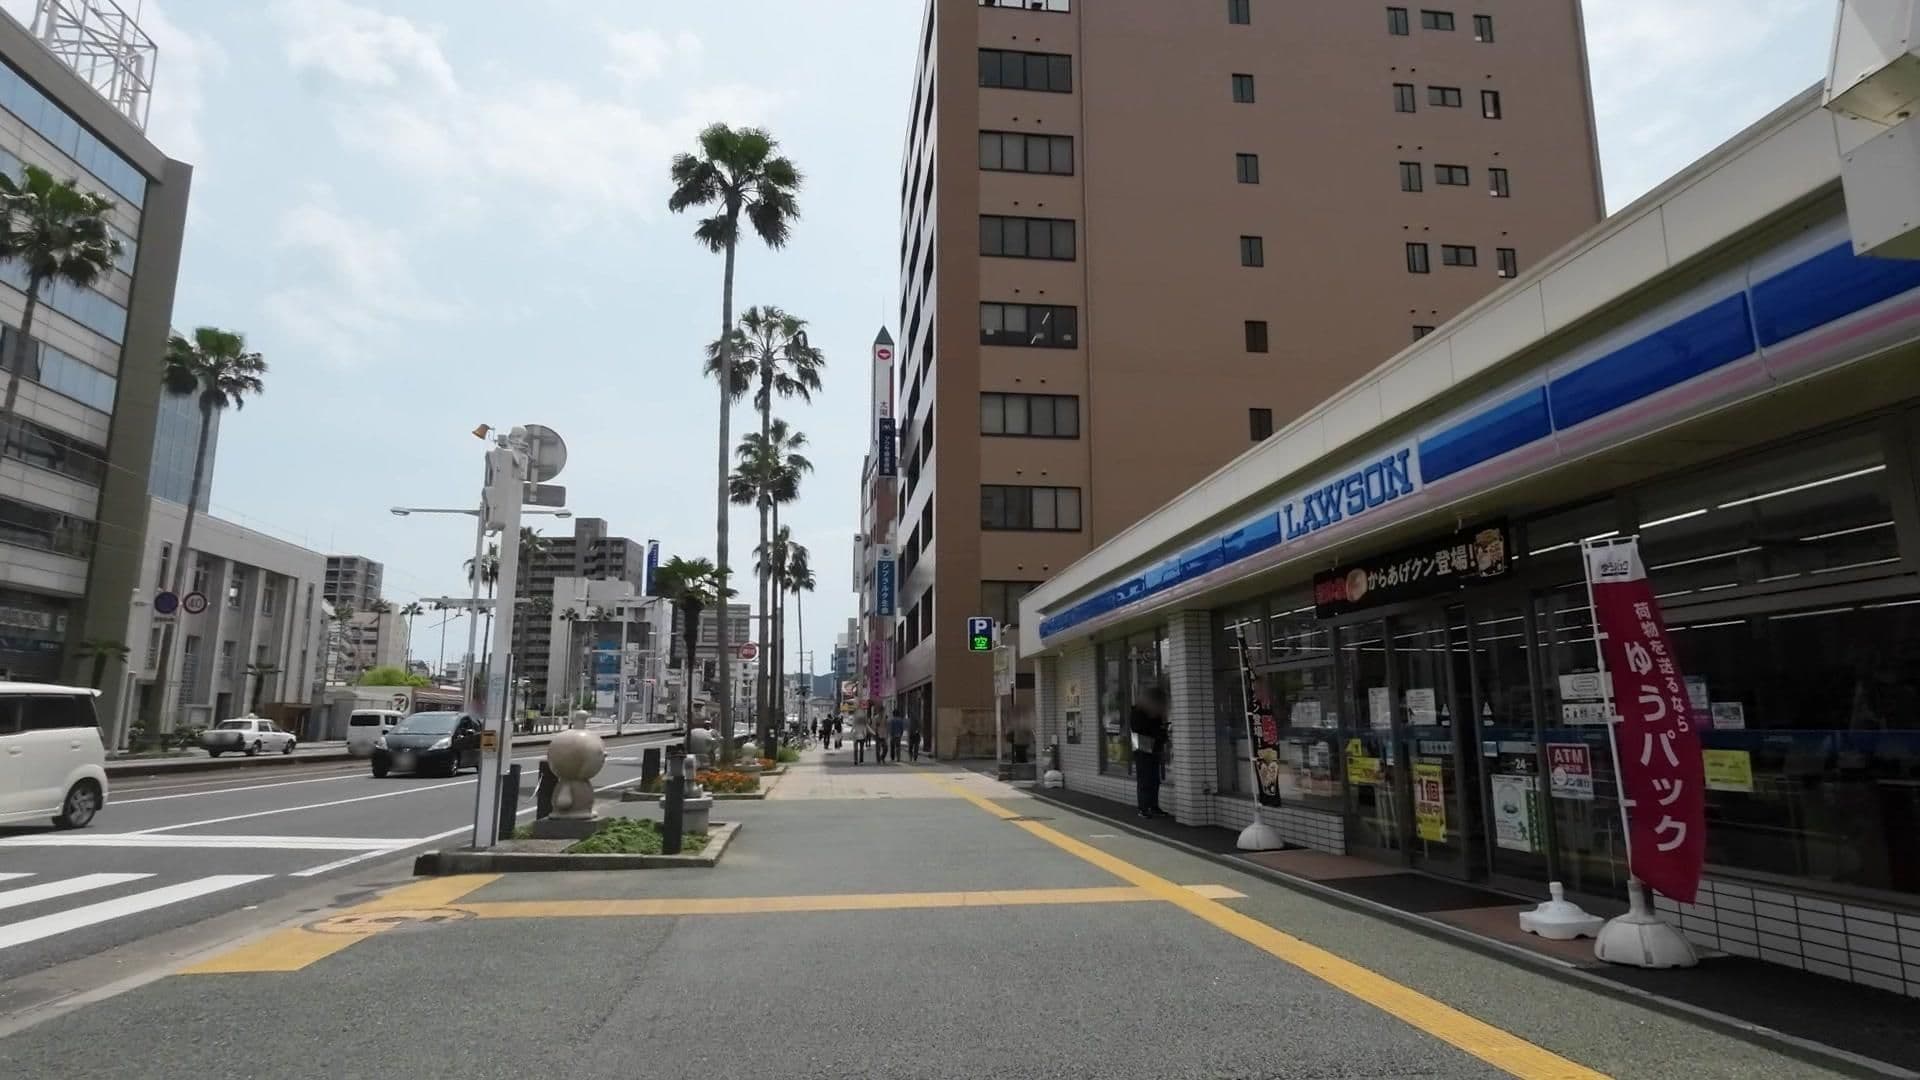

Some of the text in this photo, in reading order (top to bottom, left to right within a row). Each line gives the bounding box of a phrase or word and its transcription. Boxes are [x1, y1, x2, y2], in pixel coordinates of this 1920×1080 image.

[1284, 448, 1414, 541] LAWSON
[1367, 543, 1476, 592] からあげクン登場!
[974, 636, 988, 650] 空
[975, 620, 988, 634] P
[1633, 601, 1688, 733] 荷物を送るなら
[1554, 748, 1584, 764] ATM
[1624, 641, 1687, 853] ゆうパック
